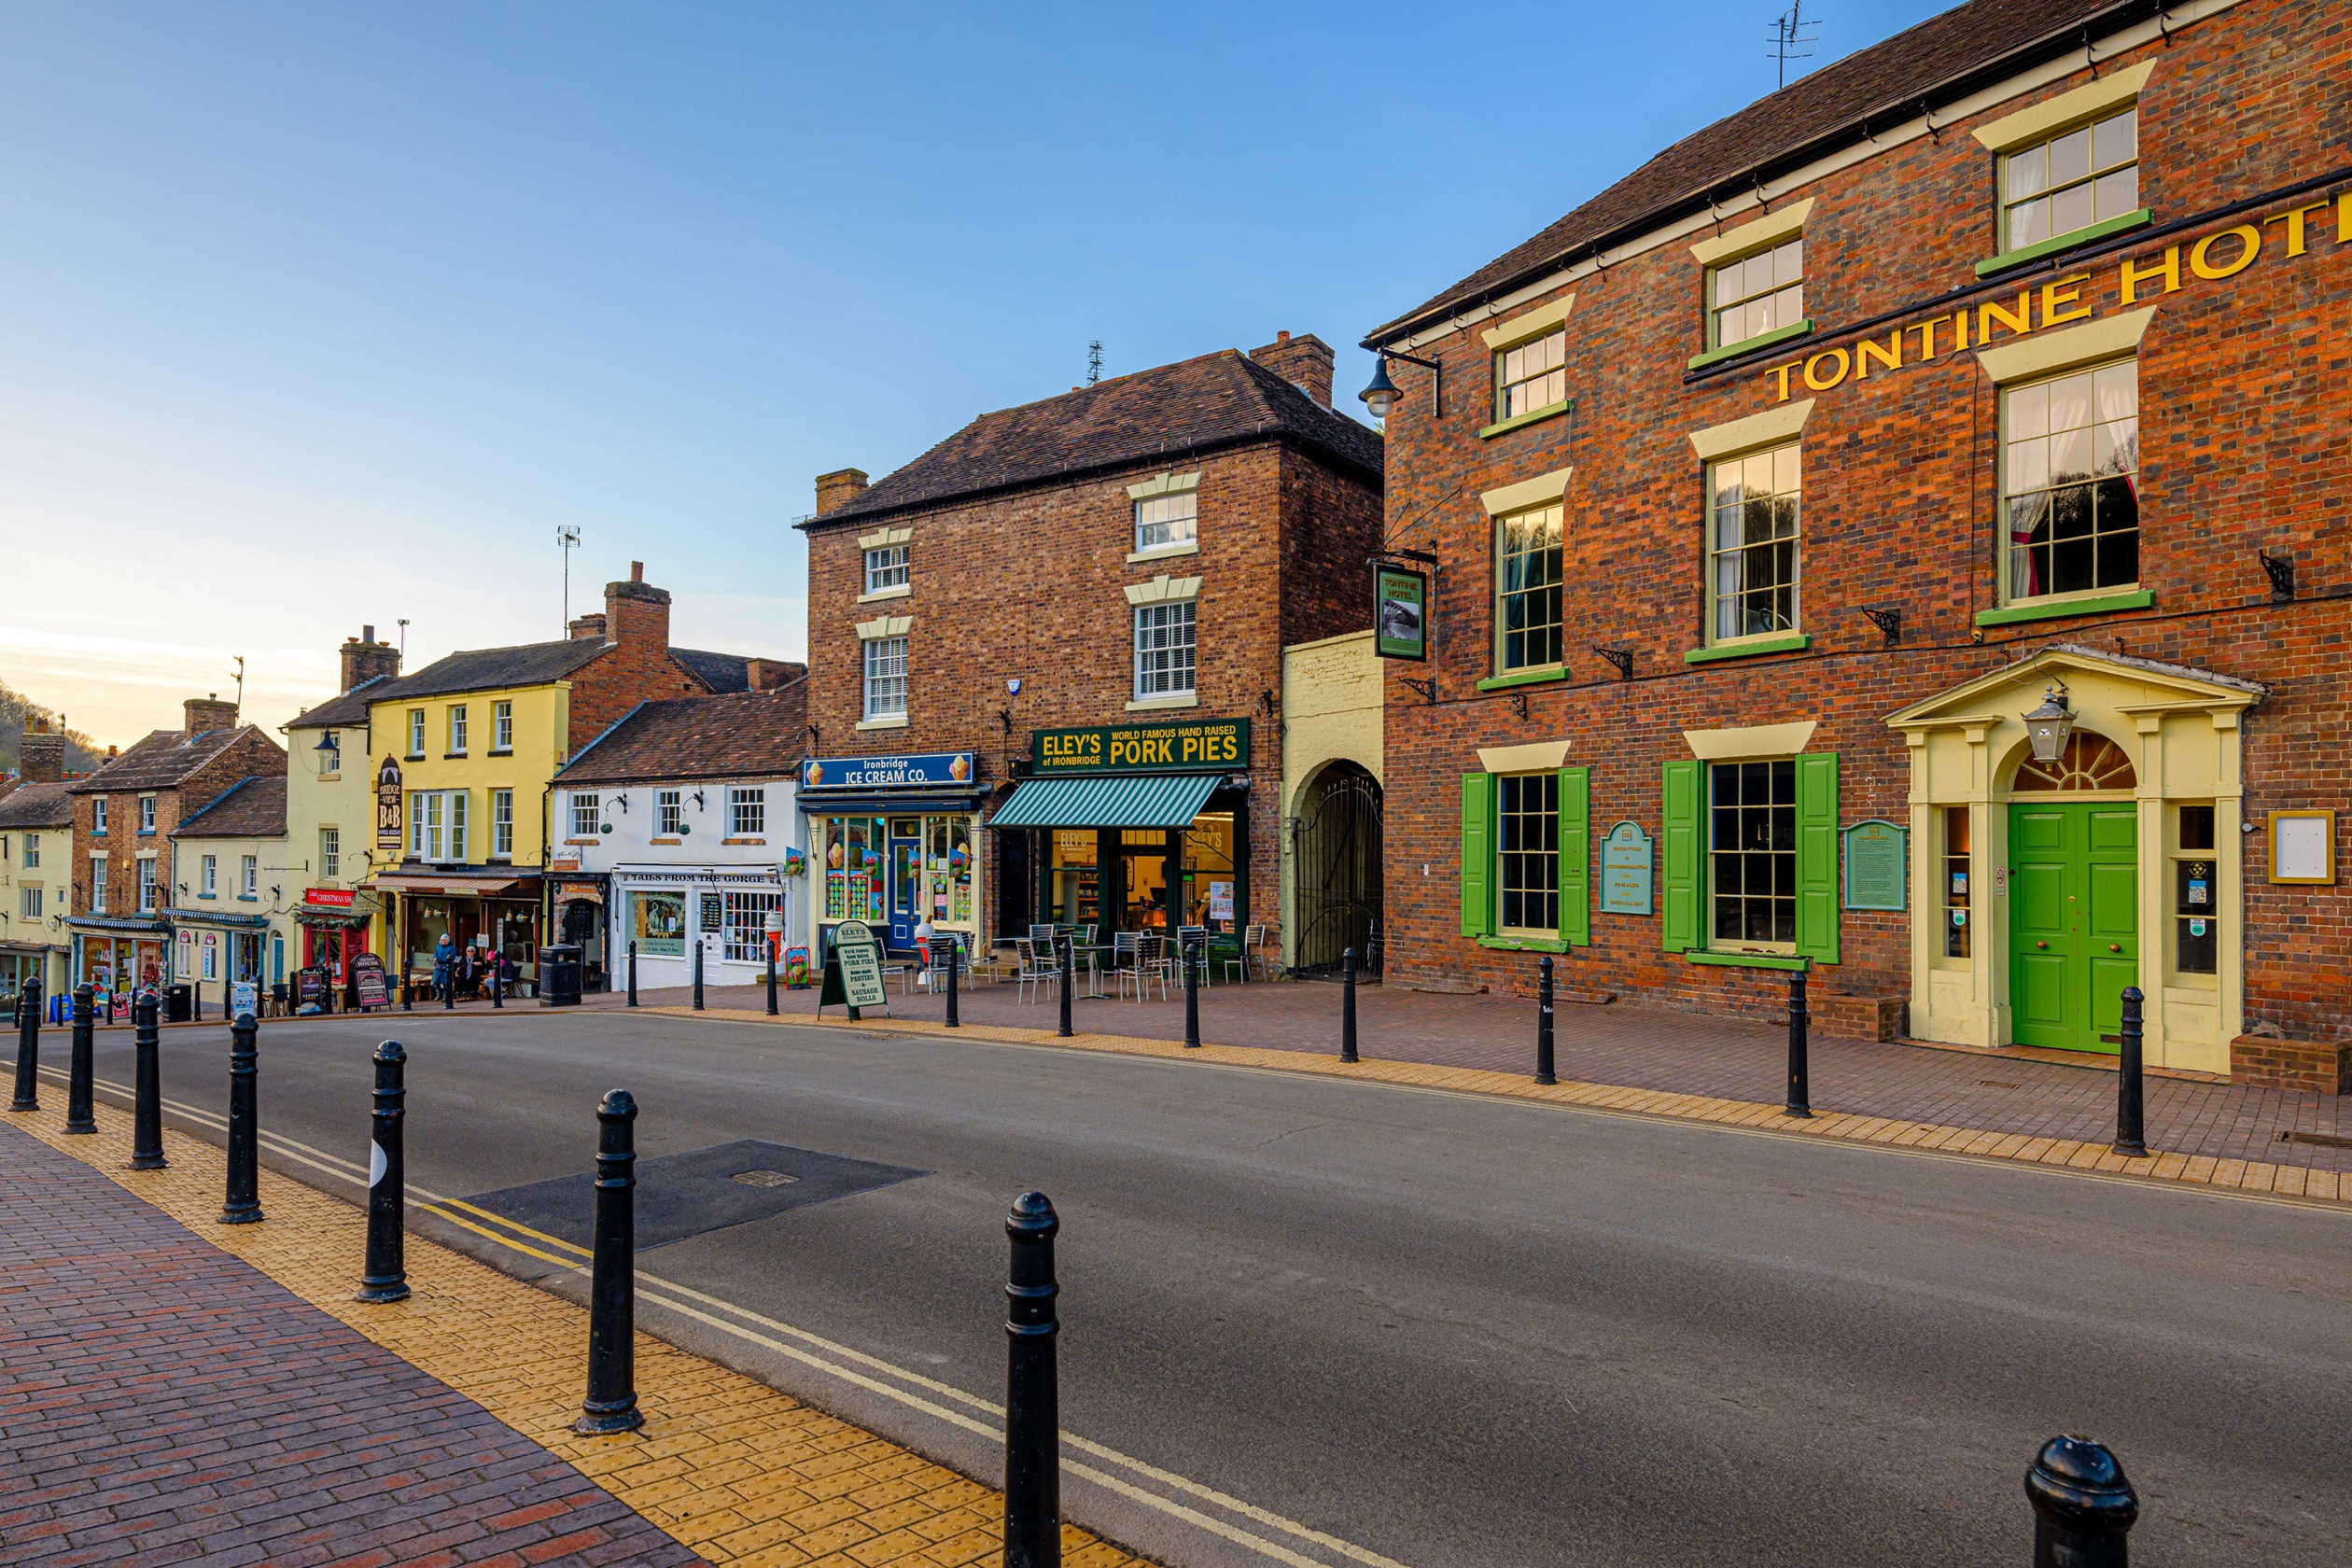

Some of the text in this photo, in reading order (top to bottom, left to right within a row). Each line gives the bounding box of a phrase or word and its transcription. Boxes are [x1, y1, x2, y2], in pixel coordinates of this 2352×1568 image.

[1765, 272, 2093, 402] TONTINE
[1384, 579, 1417, 591] TONTINE
[1388, 589, 1413, 600] HOTEL
[1112, 725, 1236, 741] WORLD FAMOUS HAND RAISED
[1043, 734, 1101, 756] ELEY'S
[1110, 735, 1238, 765] PORK PIES
[863, 758, 908, 770] Ironbridge
[1043, 755, 1101, 766] of IRONBRIDGE
[845, 769, 928, 784] ICE CREAM CO.
[379, 785, 400, 795] BRIDGE
[382, 795, 397, 804] VIEW
[379, 805, 400, 828] B&B
[1061, 833, 1087, 847] ELEY'S
[723, 875, 764, 883] GORGE
[316, 893, 344, 903] CHRISTMAS
[850, 974, 875, 983] PASTIES
[851, 987, 878, 996] SAUSAGE
